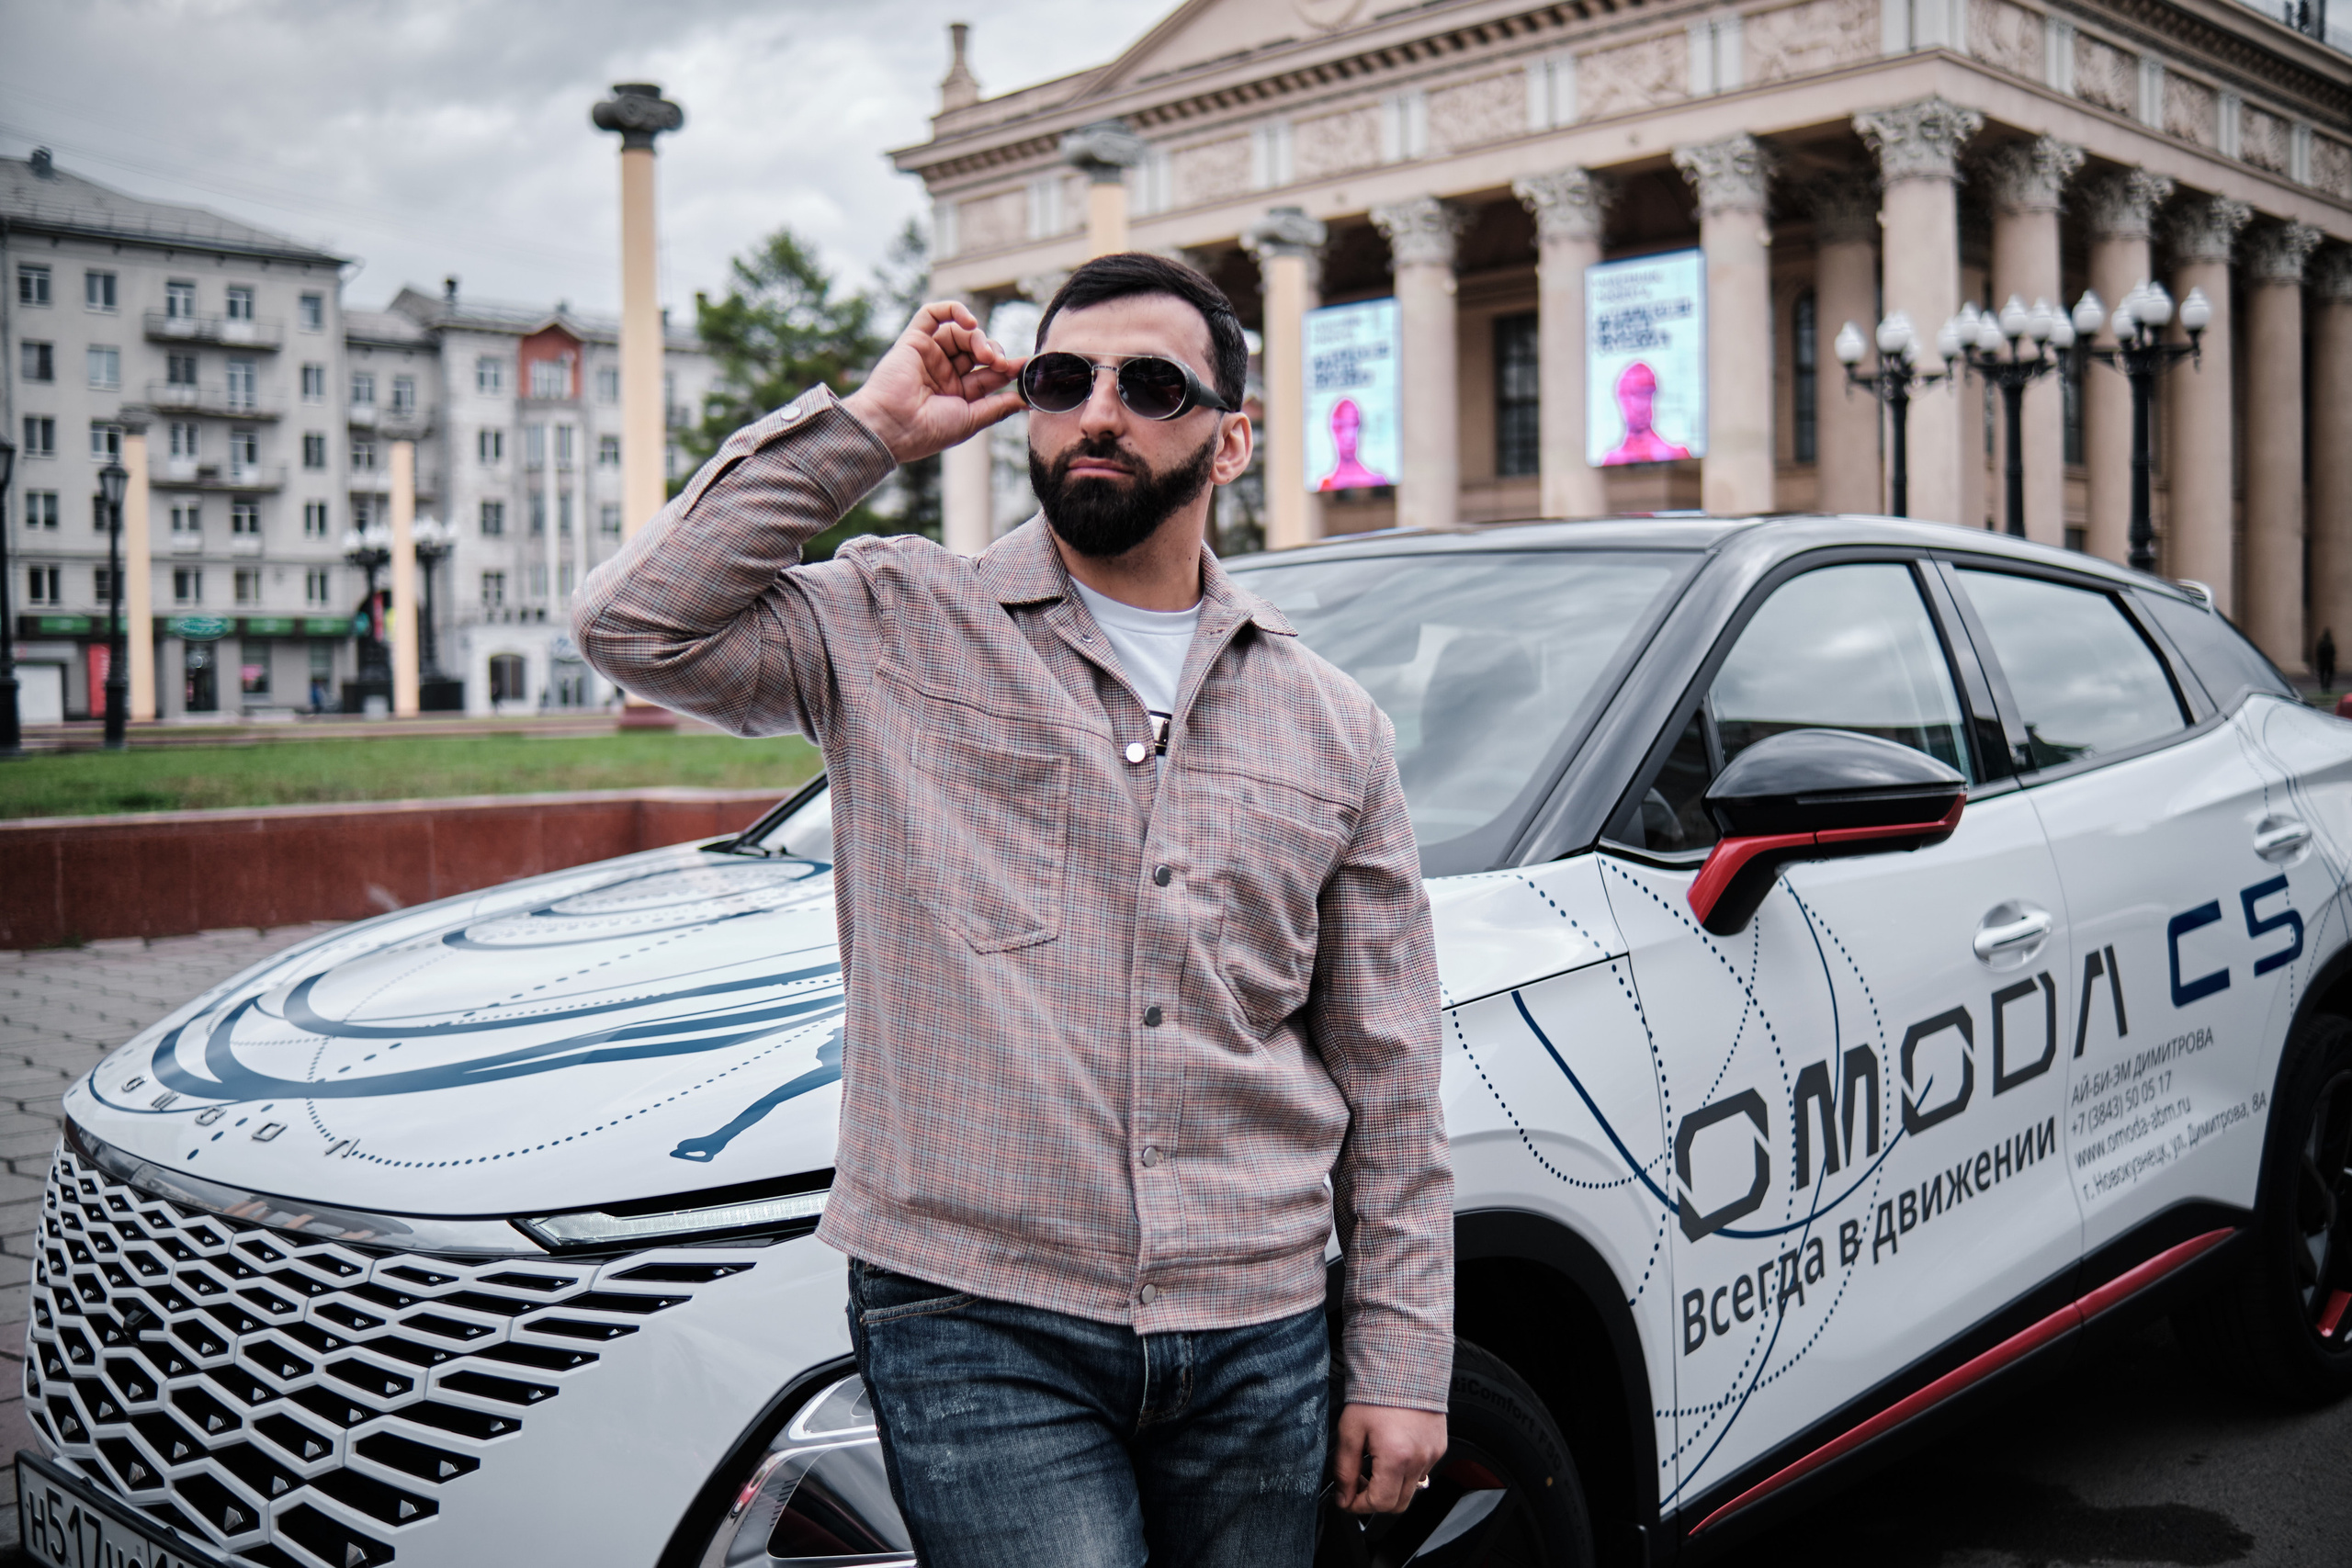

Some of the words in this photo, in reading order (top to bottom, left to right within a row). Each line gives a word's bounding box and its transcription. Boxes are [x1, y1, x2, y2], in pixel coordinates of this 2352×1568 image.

[2167, 872, 2304, 1010] C5
[2071, 1059, 2131, 1108] АЙ-БИ-ЭМ
[2133, 1025, 2214, 1082] ДИМИТРОВА
[2071, 1112, 2086, 1136] +7
[2087, 1093, 2124, 1135] (3843)
[2125, 1085, 2140, 1112] 50
[2142, 1078, 2155, 1103] 05
[2159, 1069, 2173, 1095] 17
[1682, 1235, 1826, 1357] Всегда
[1839, 1219, 1860, 1268] в
[1872, 1115, 2056, 1265] движении
[1452, 1376, 1536, 1432] tiComfort
